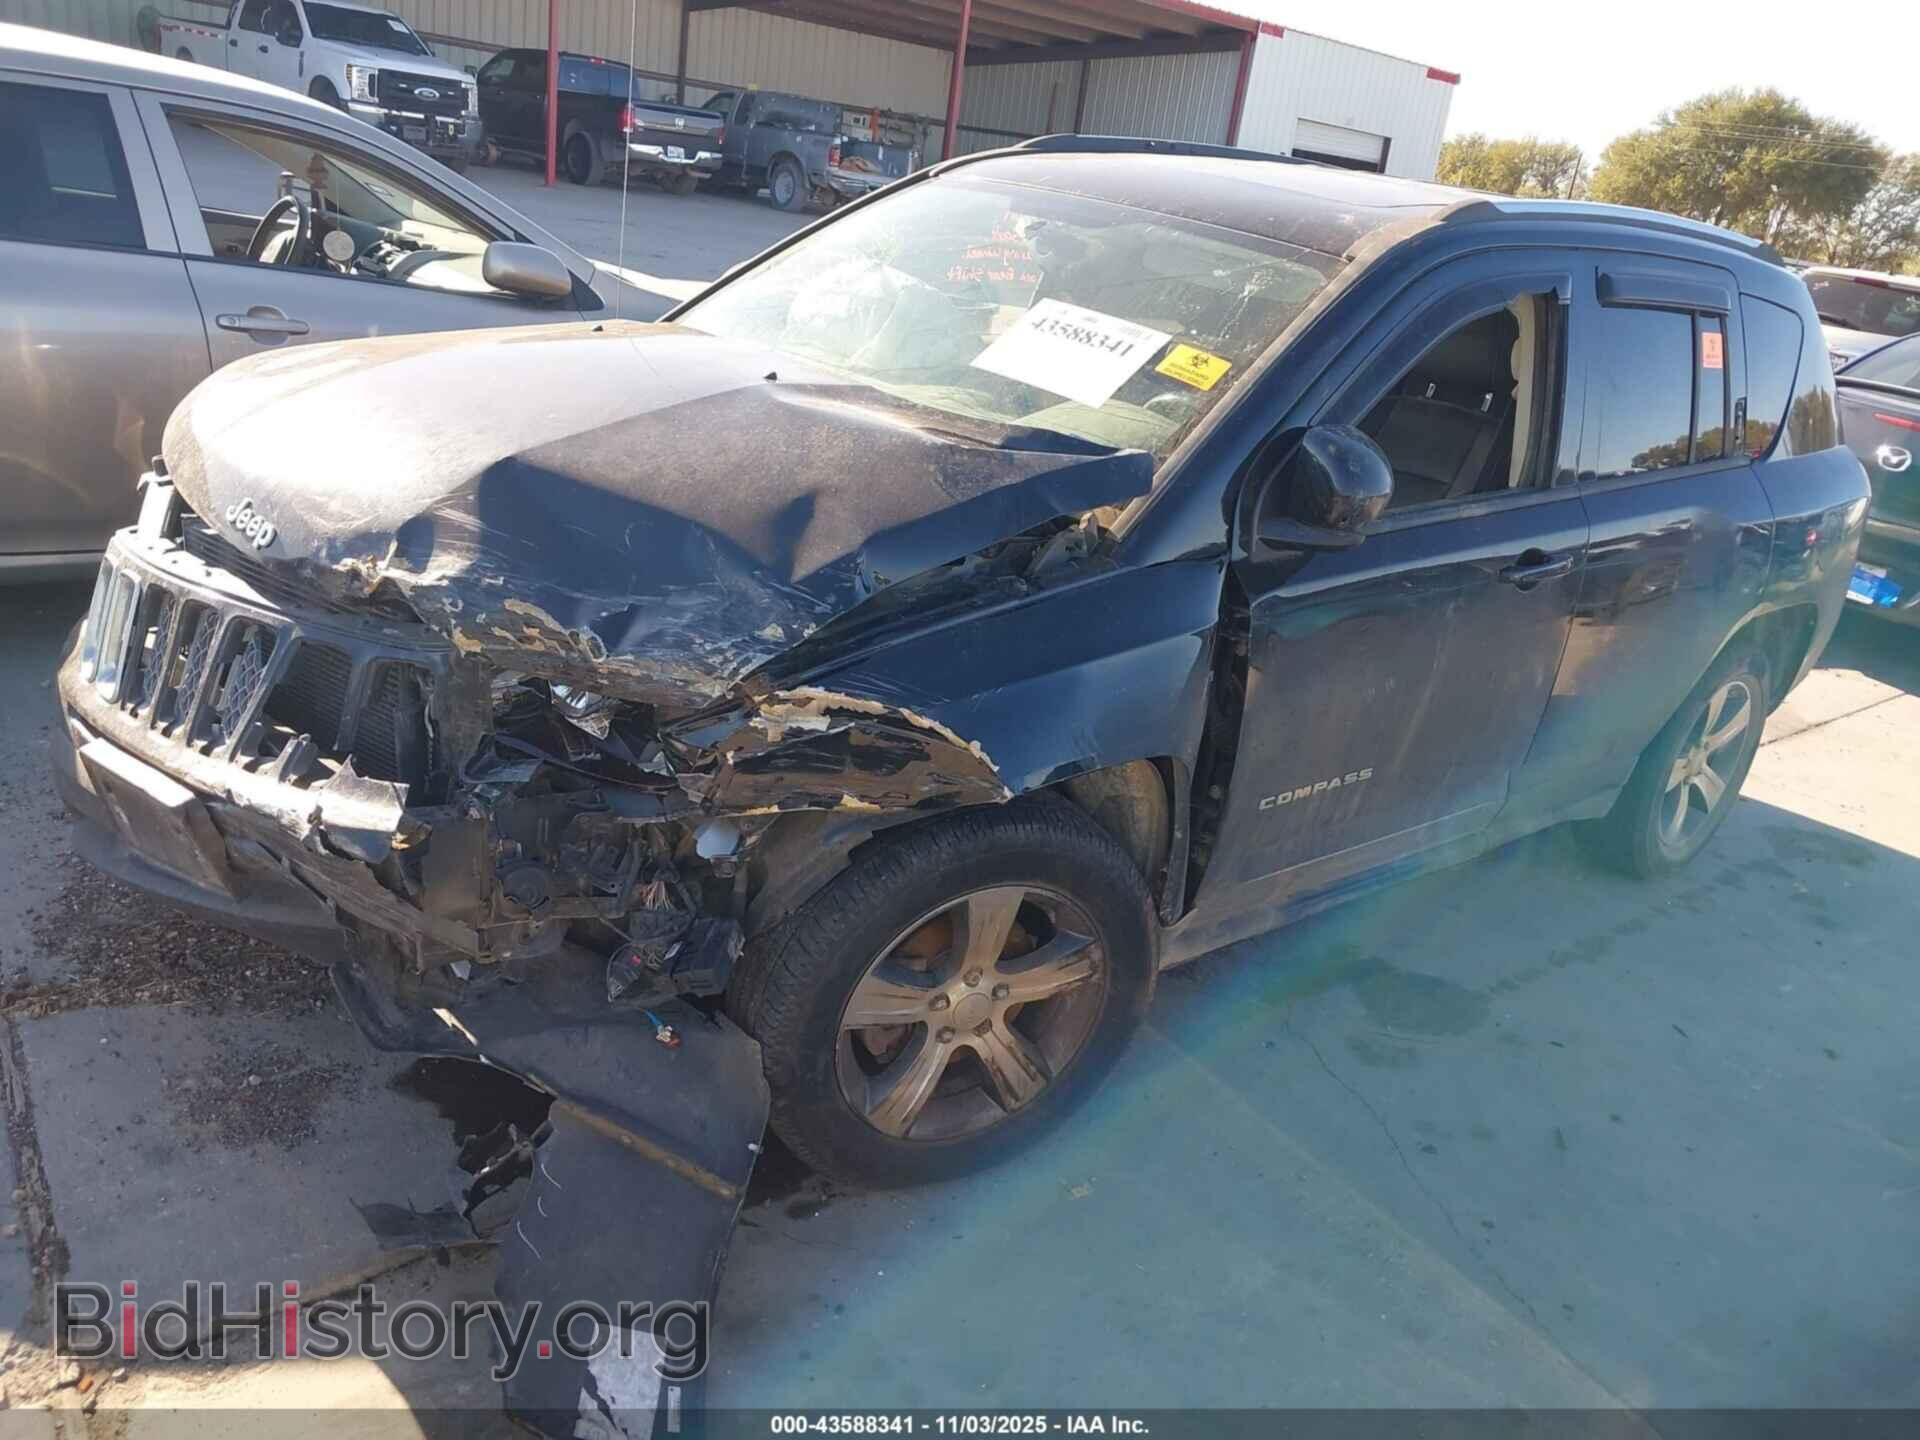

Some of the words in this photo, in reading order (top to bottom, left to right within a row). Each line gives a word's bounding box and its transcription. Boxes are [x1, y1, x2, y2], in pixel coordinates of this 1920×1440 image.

[1031, 317, 1135, 358] 43588341
[225, 496, 275, 549] Jeep
[1258, 767, 1374, 811] COMPASS
